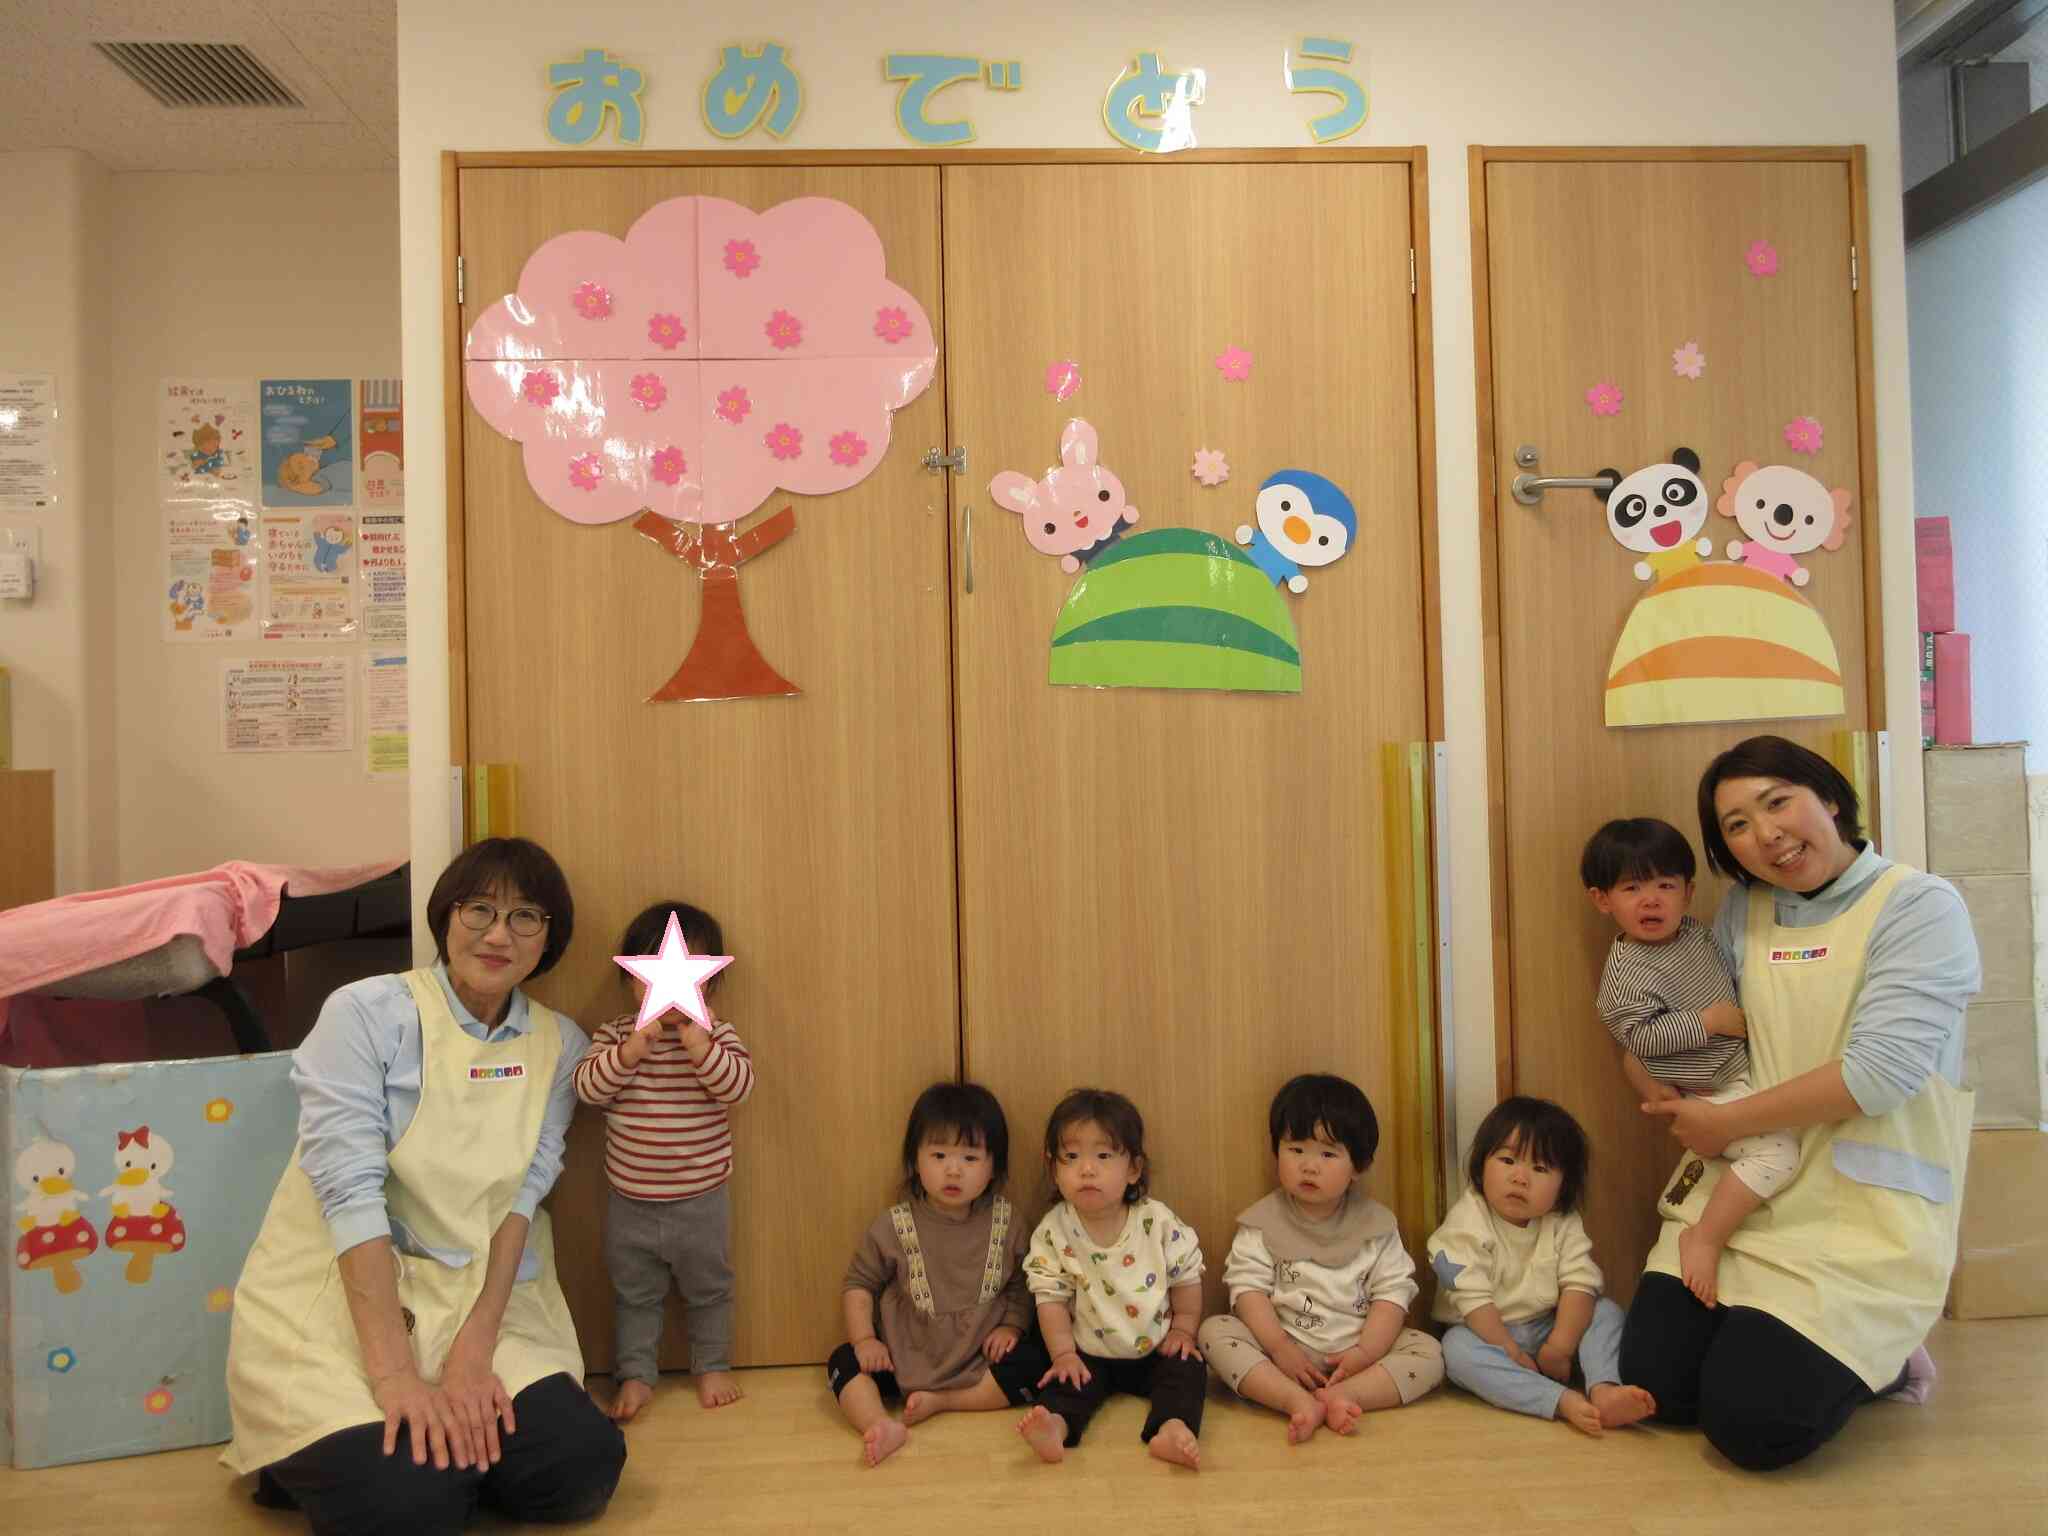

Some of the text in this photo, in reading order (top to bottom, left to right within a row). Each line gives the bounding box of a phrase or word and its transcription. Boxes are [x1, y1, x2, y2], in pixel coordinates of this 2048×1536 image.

[547, 36, 1370, 154] おめでとう
